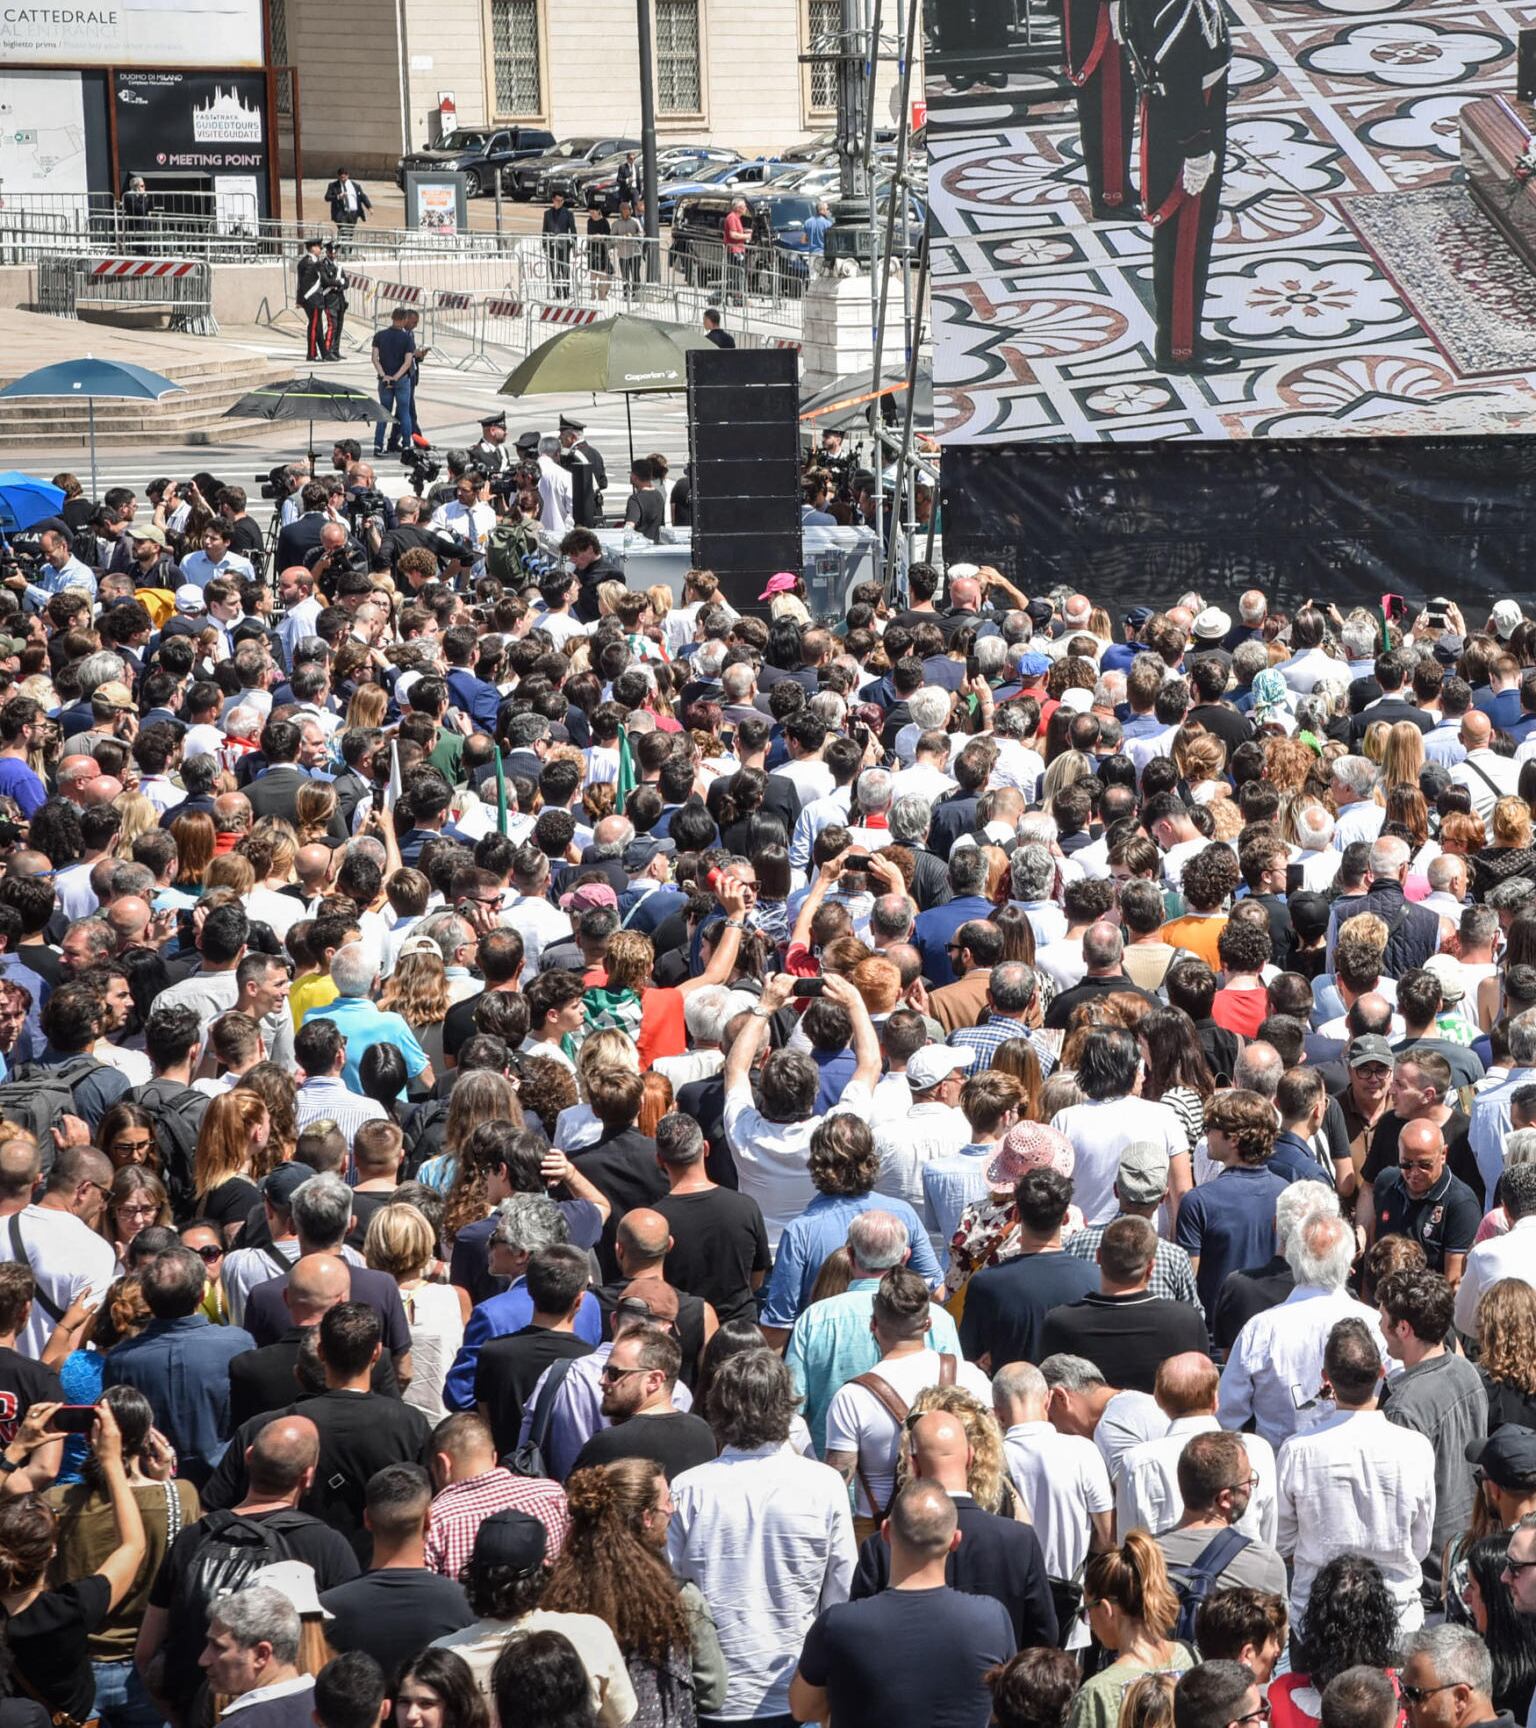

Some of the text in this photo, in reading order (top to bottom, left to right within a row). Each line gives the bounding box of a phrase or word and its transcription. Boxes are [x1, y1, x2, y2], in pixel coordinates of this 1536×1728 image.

[4, 9, 118, 24] CATTEDRALE
[169, 154, 262, 166] MEETING POINT
